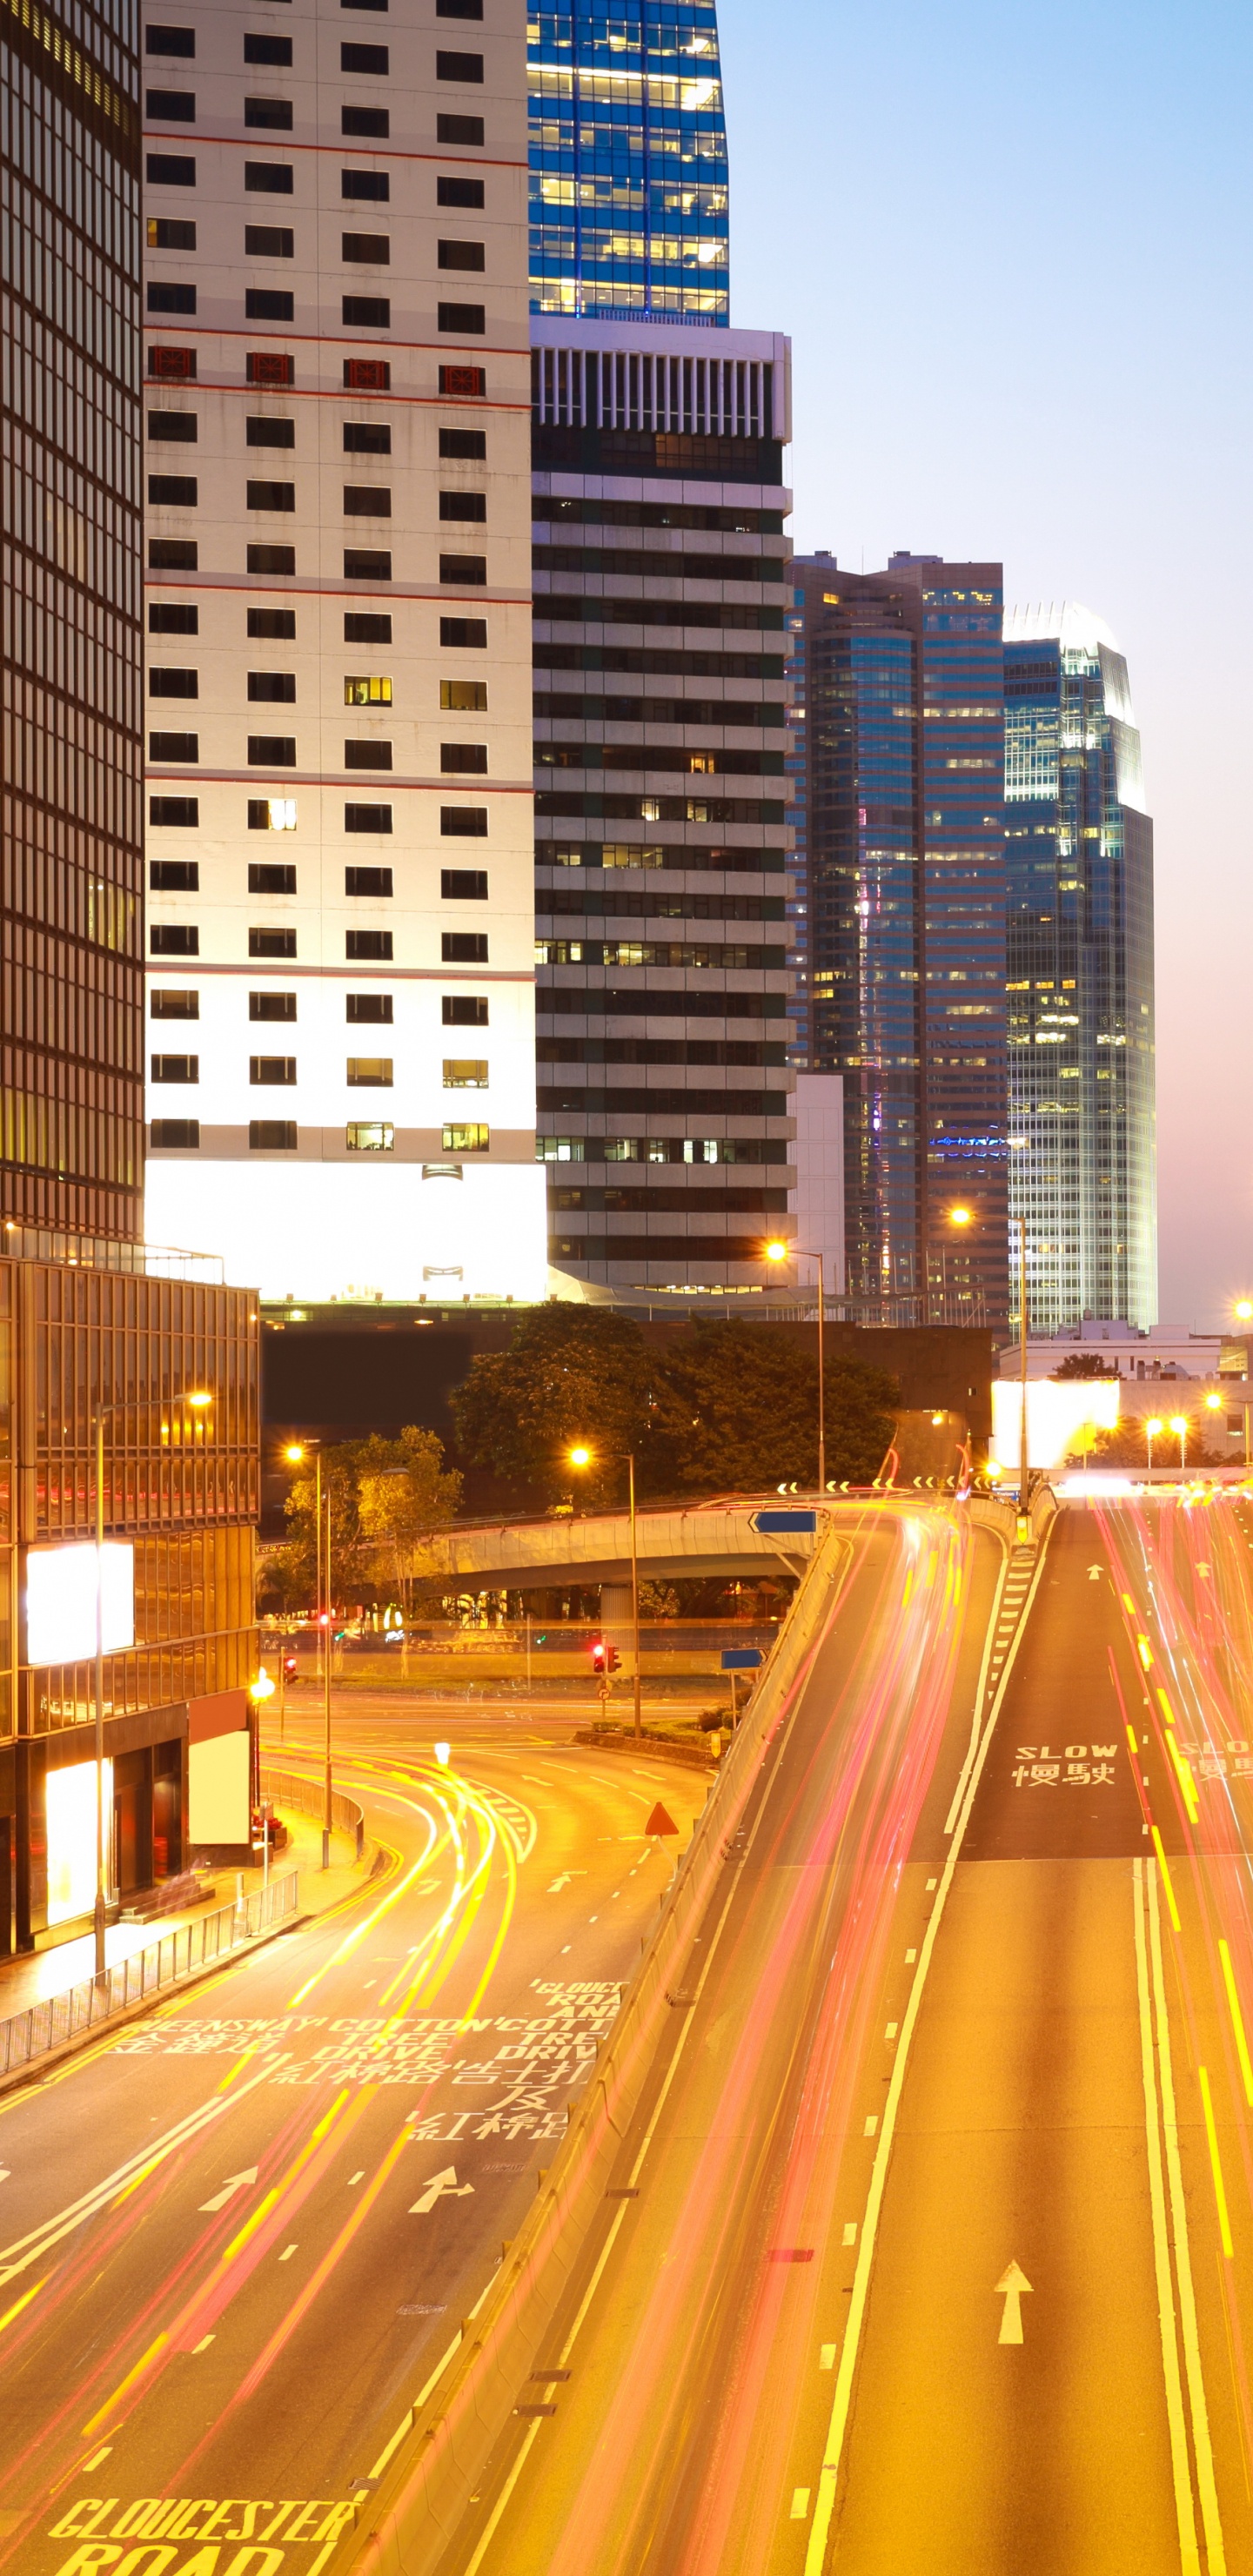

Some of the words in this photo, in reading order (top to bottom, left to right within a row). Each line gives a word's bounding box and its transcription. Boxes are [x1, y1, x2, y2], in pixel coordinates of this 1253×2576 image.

[1015, 1744, 1118, 1760] SLOW
[1011, 1762, 1116, 1787] 慢駛
[328, 2018, 493, 2032] COTTON
[104, 2031, 285, 2054] 金鐘道
[341, 2032, 457, 2045] TREE
[519, 2031, 609, 2045] TRE
[310, 2046, 452, 2060] DRIVE
[268, 2060, 452, 2084] 紅棉路
[452, 2059, 596, 2084] 告士打
[485, 2085, 559, 2111] 及
[48, 2498, 361, 2541] GLOUCESTER
[55, 2543, 285, 2576] ROAD
